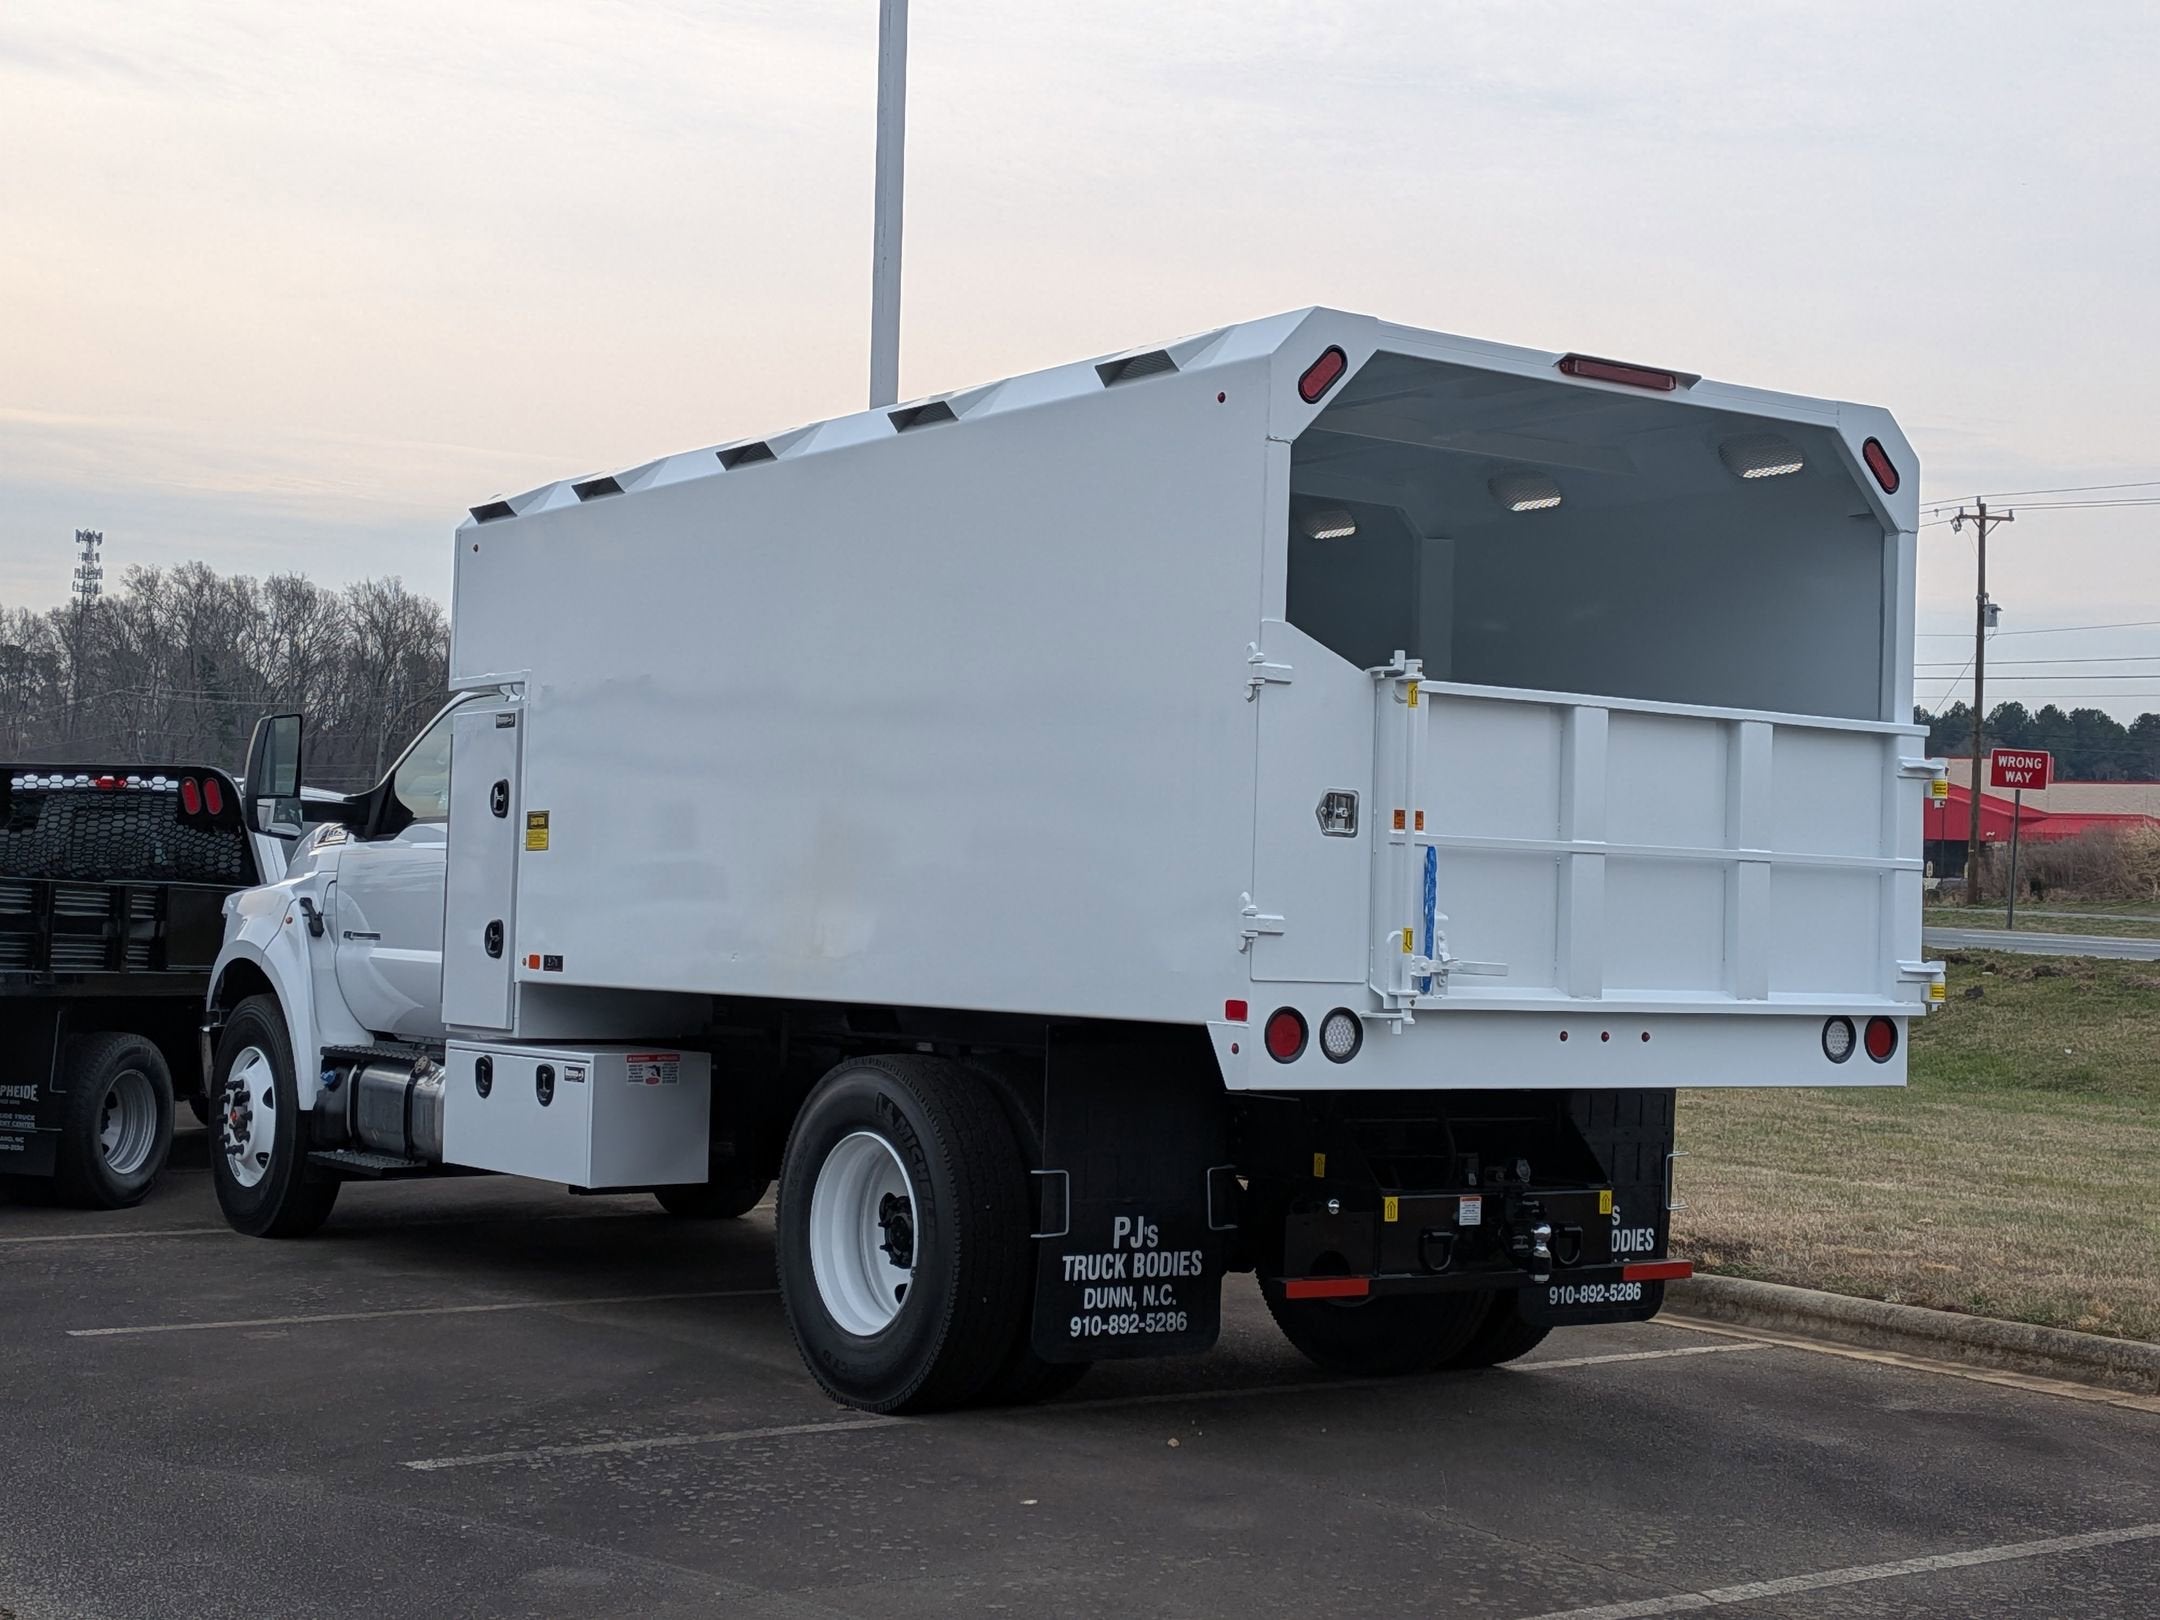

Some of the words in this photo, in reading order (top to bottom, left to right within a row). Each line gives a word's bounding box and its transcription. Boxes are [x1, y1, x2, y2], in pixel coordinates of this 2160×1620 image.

[1998, 755, 2042, 769] WRONG
[2005, 770, 2033, 783] WAY
[1611, 1227, 1655, 1252] ODIES
[1062, 1253, 1128, 1281] TRUCK
[1132, 1250, 1203, 1278] BODIES
[1083, 1286, 1137, 1311] DUNN,
[1142, 1283, 1177, 1307] N.C.
[1549, 1282, 1642, 1305] 910-892-5286
[1070, 1311, 1188, 1337] 910-892-5286
